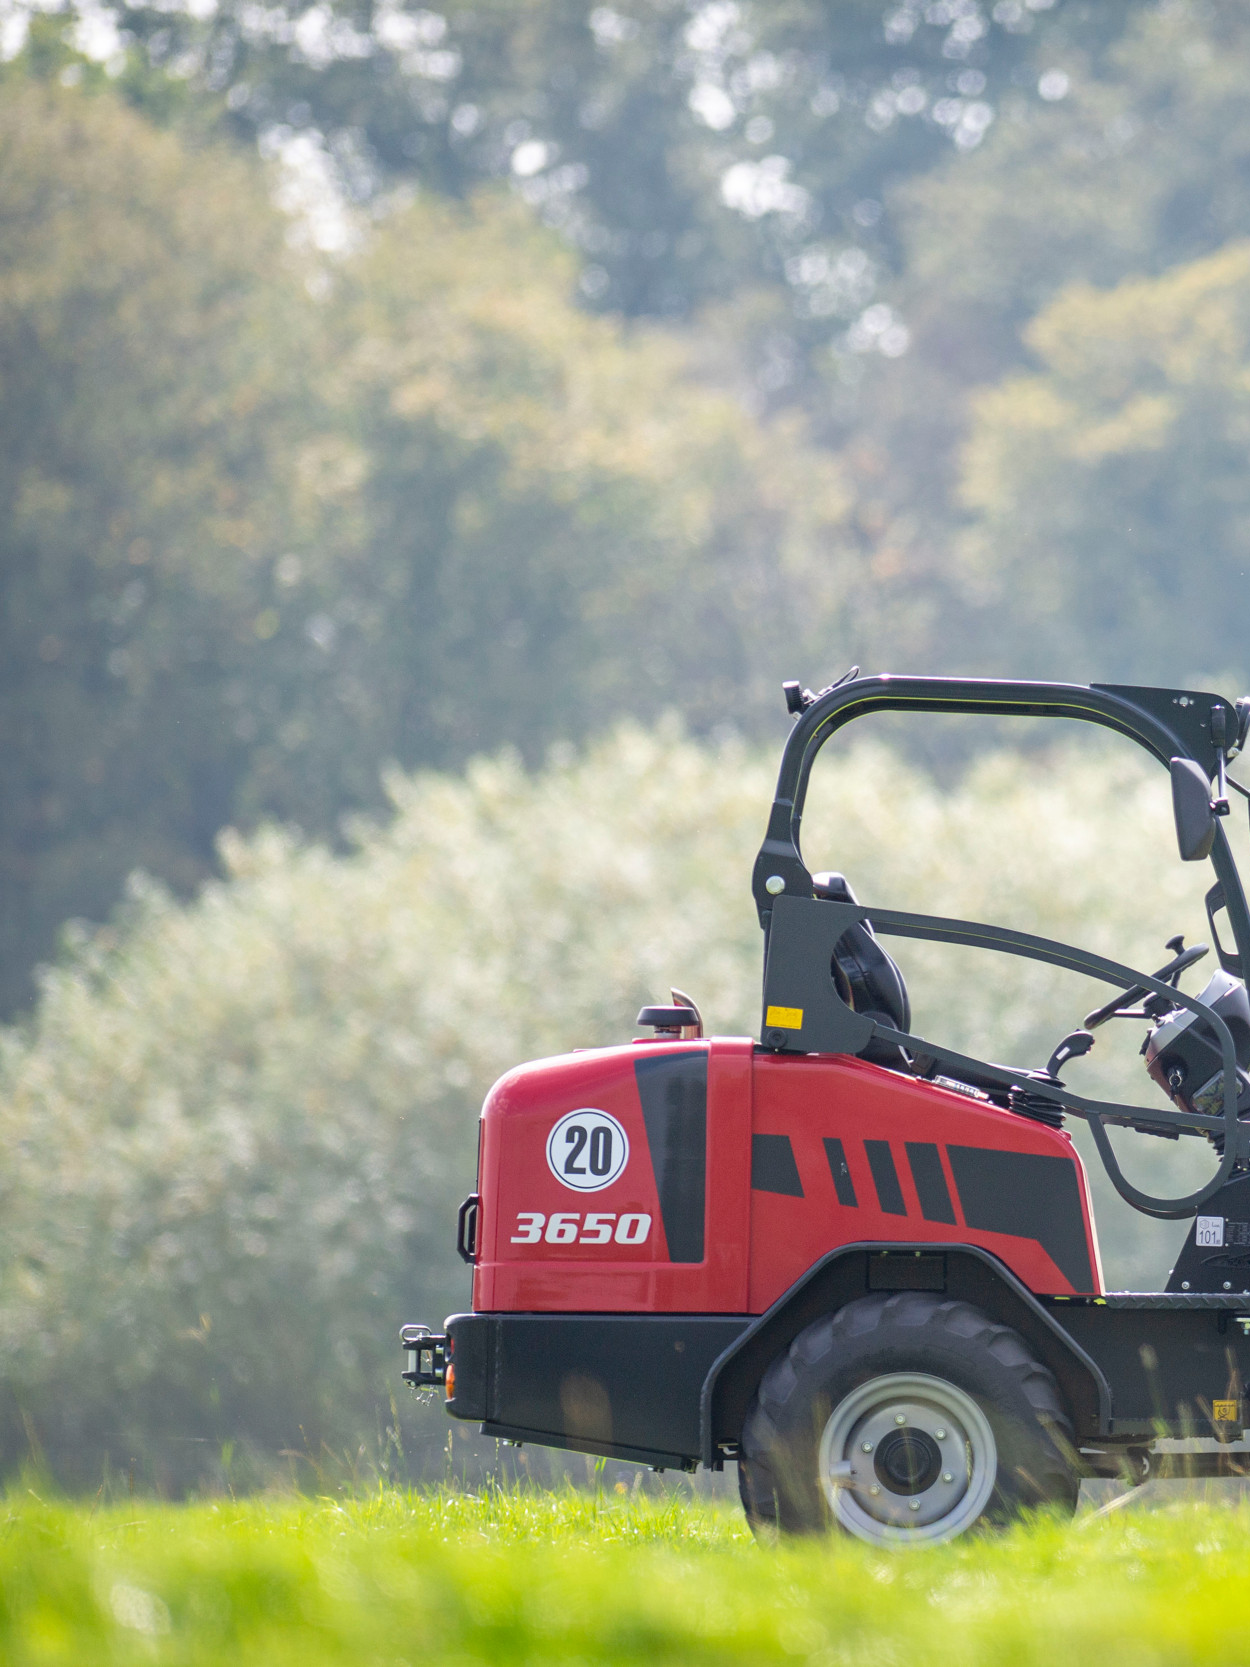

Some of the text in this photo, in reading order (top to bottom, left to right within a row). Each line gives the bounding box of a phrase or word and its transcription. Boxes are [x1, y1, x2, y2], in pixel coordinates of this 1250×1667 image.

[564, 1125, 613, 1176] 20
[510, 1212, 652, 1245] 3650
[1199, 1230, 1216, 1244] 101
